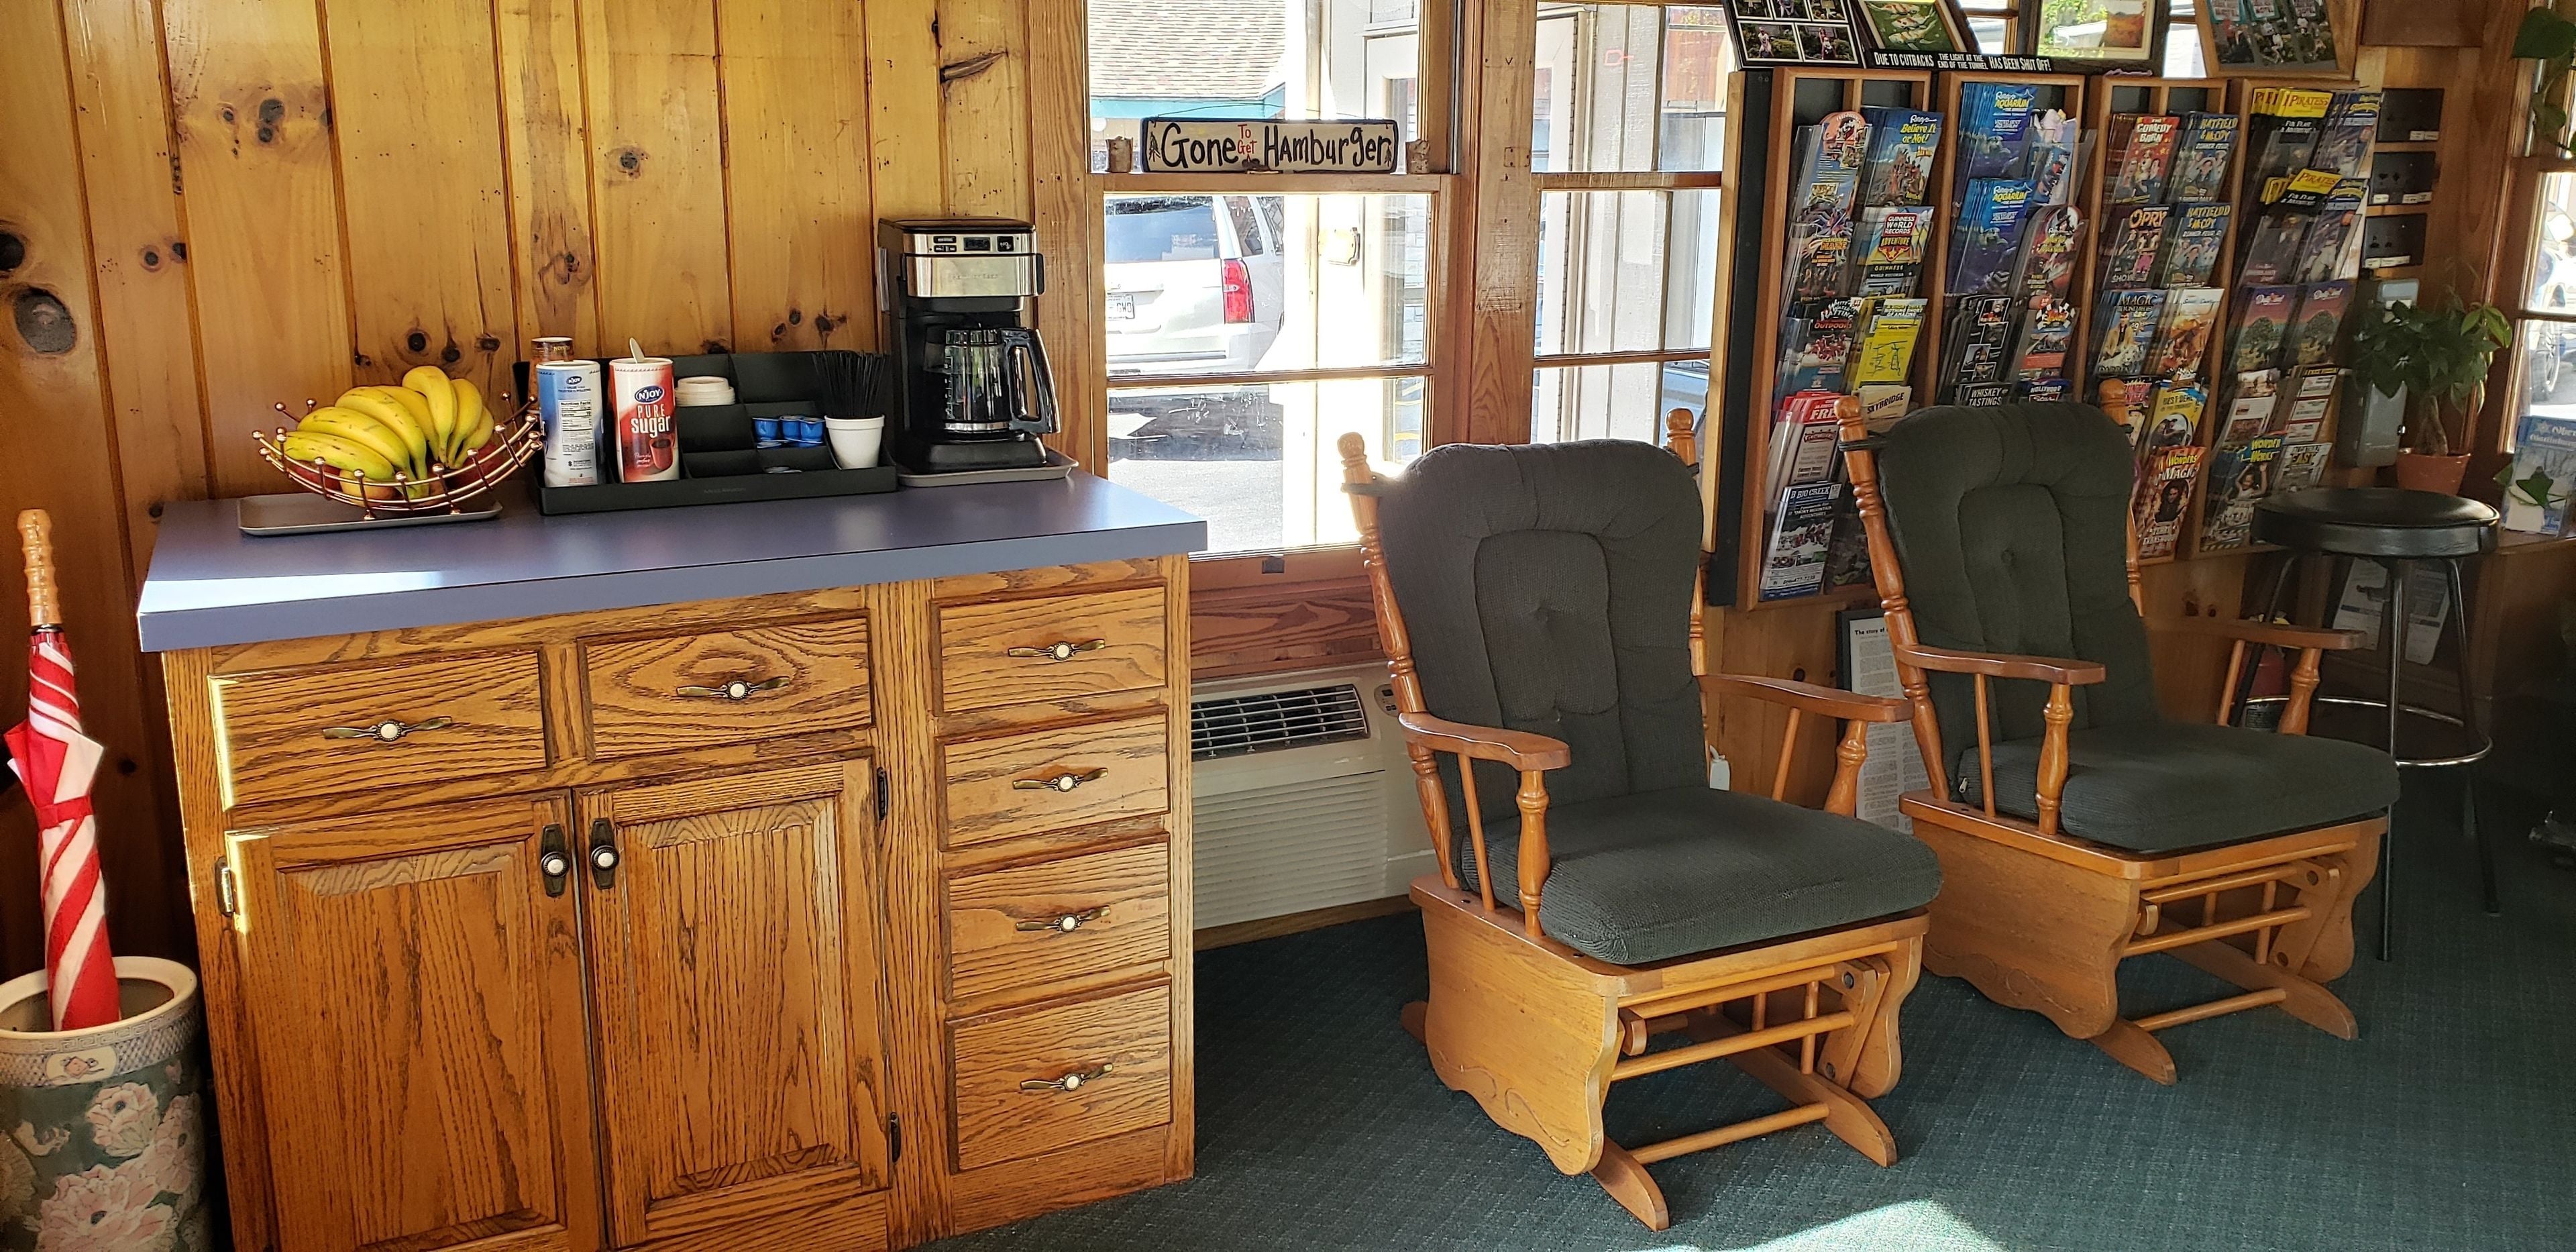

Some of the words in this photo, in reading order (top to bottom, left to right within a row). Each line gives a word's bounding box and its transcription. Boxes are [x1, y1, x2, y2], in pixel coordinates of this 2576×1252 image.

[1874, 52, 1890, 65] DUE
[1888, 53, 1899, 66] TO
[1899, 54, 1935, 67] CUTBACKS
[1949, 53, 1965, 61] LIGHT
[1966, 54, 1972, 62] AT
[1988, 56, 2003, 69] HAS
[2002, 56, 2021, 70] BEEN
[2019, 57, 2037, 71] SHUT
[2036, 58, 2052, 72] OFF!
[1937, 60, 1949, 68] END
[1949, 60, 1955, 68] OF
[1957, 61, 1968, 69] THE
[1968, 62, 1988, 70] TUNNEL
[1238, 123, 1251, 139] To
[1900, 123, 1927, 134] Believe
[2137, 123, 2173, 134] COMEDY
[1161, 123, 1239, 168] Gone
[1902, 134, 1912, 143] or
[1912, 134, 1929, 144] Not!
[1237, 140, 1258, 155] Get
[1264, 125, 1392, 168] Hamburger
[2129, 209, 2168, 229] OPRY
[2116, 295, 2157, 307] MAGIC
[1971, 387, 2002, 398] WHISKEY
[1867, 392, 1905, 414] SKYBRIDGE
[1969, 397, 2002, 407] TASTINGS
[2163, 395, 2178, 405] BEST
[637, 403, 665, 418] PURE
[631, 415, 671, 438] sugar
[2290, 452, 2317, 465] EAST
